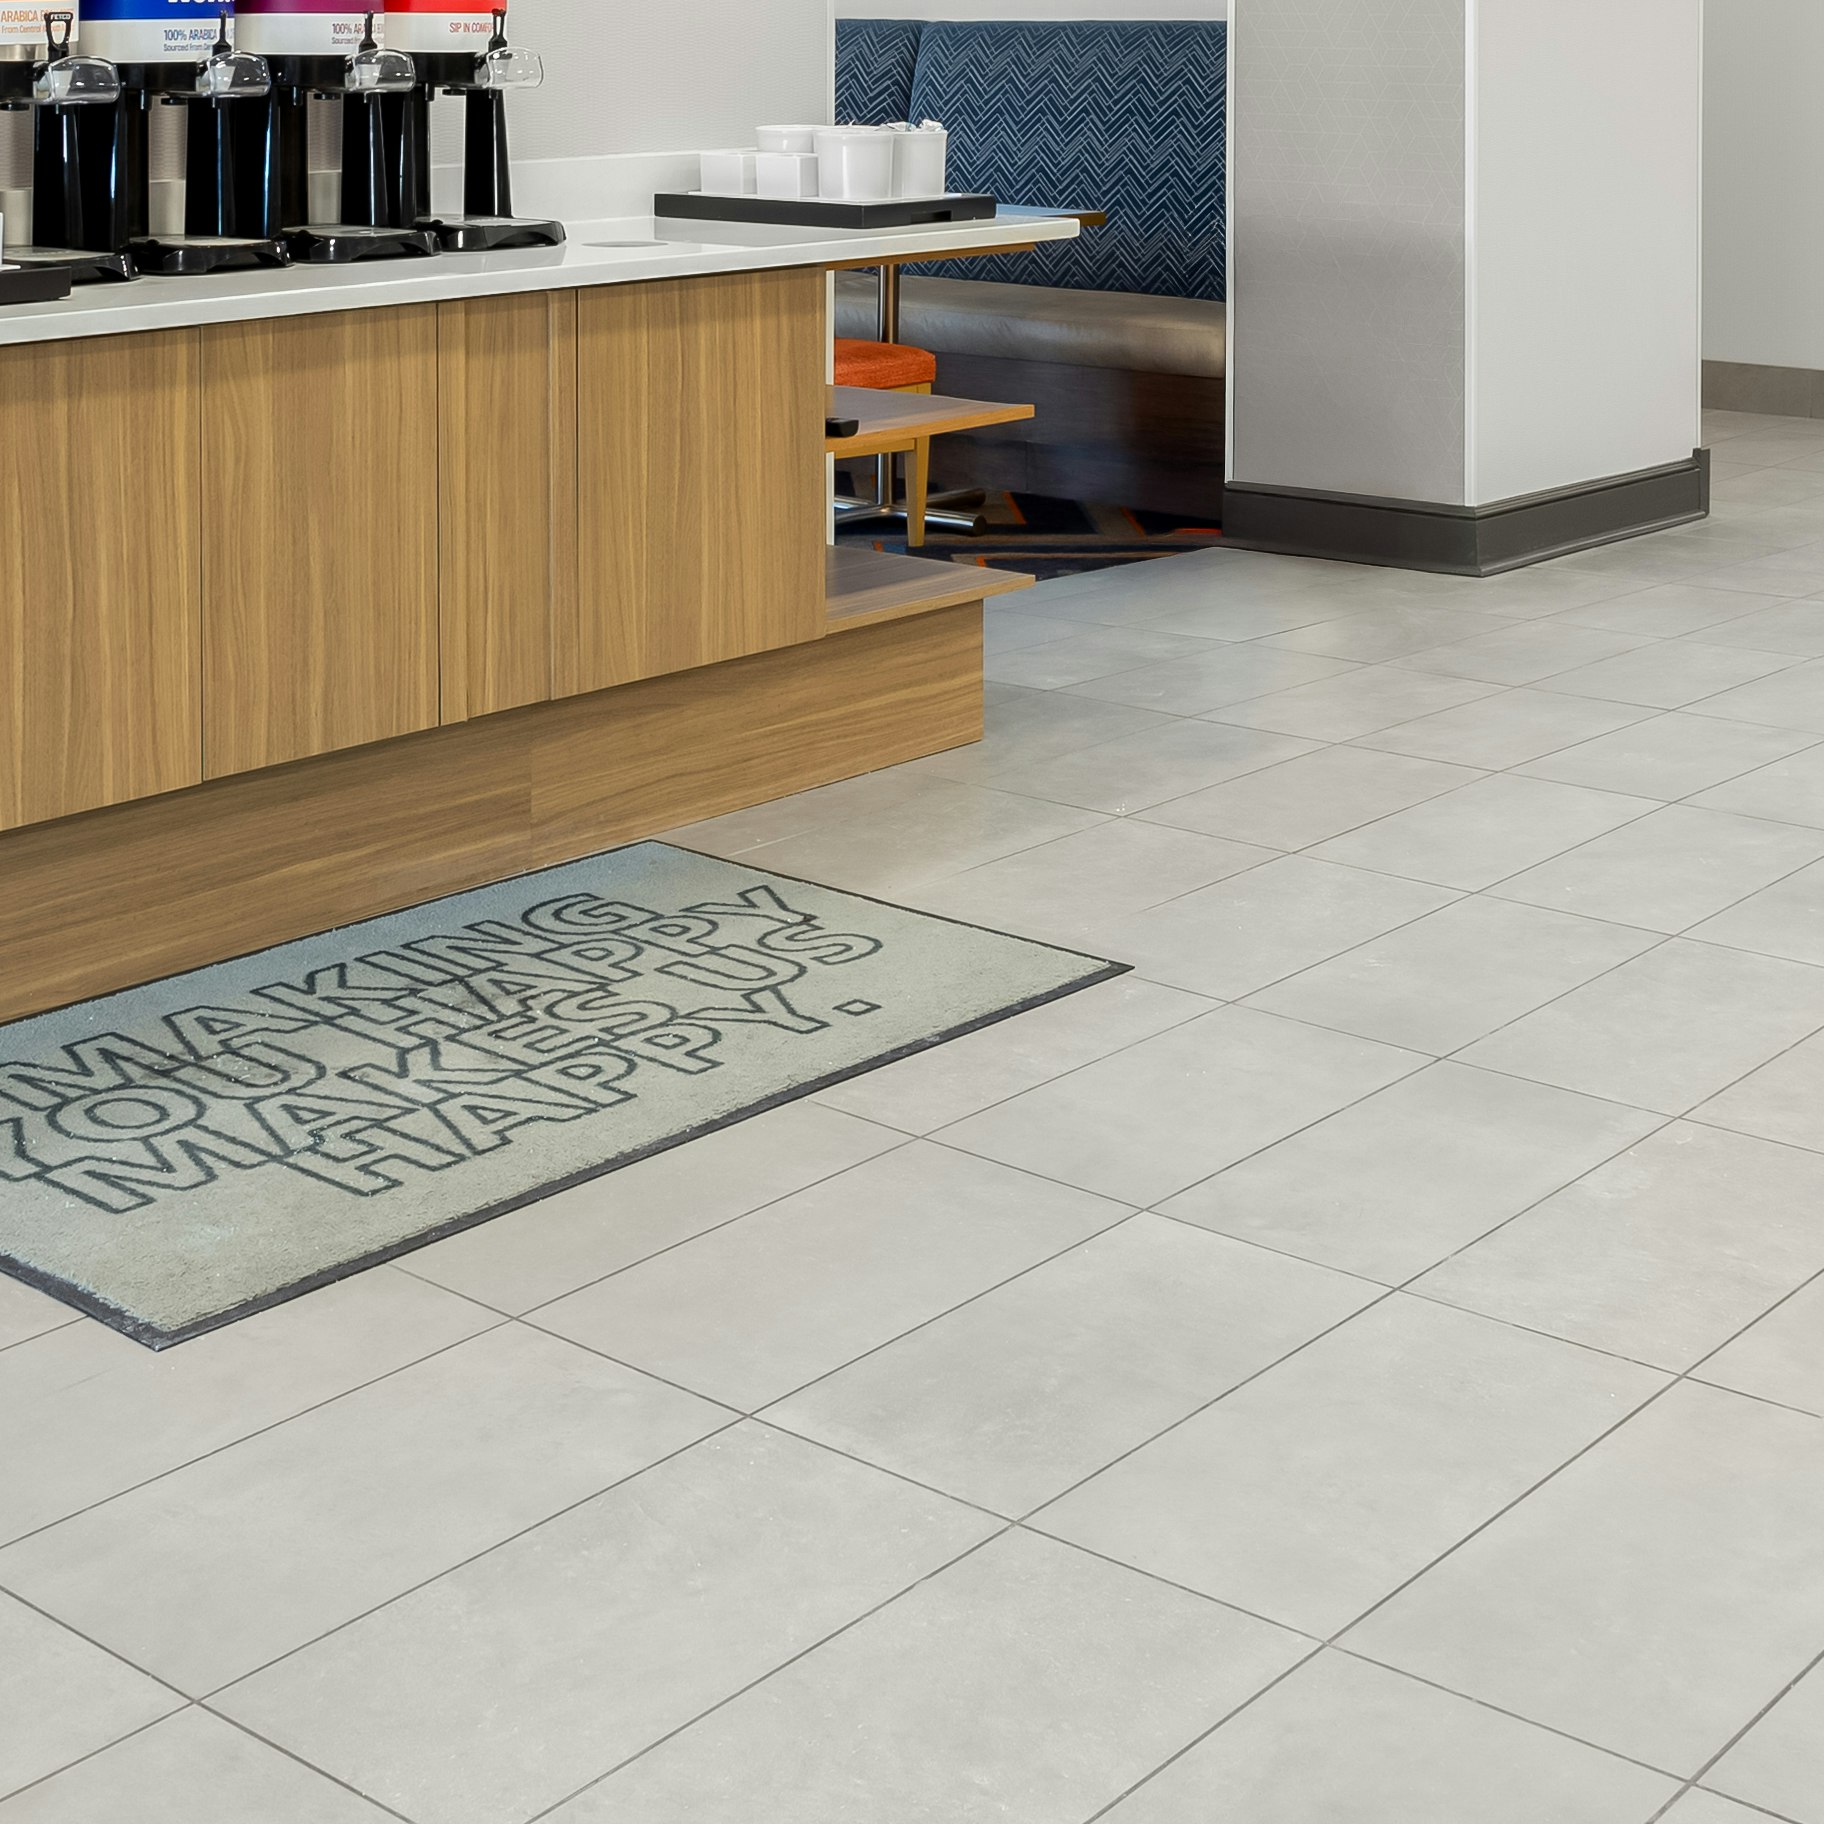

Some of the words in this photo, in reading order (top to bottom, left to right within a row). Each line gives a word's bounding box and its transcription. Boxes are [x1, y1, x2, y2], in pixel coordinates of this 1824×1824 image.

[0, 9, 38, 23] ARABICA
[1, 25, 19, 34] From
[331, 23, 353, 34] 100%
[449, 22, 462, 33] SIP
[463, 22, 470, 33] IN
[471, 22, 494, 33] COMFO
[163, 29, 187, 40] 100%
[318, 884, 820, 1049] HAPPY
[39, 984, 678, 1214] MAKES
[656, 922, 883, 991] US
[276, 988, 882, 1197] HAPPY.
